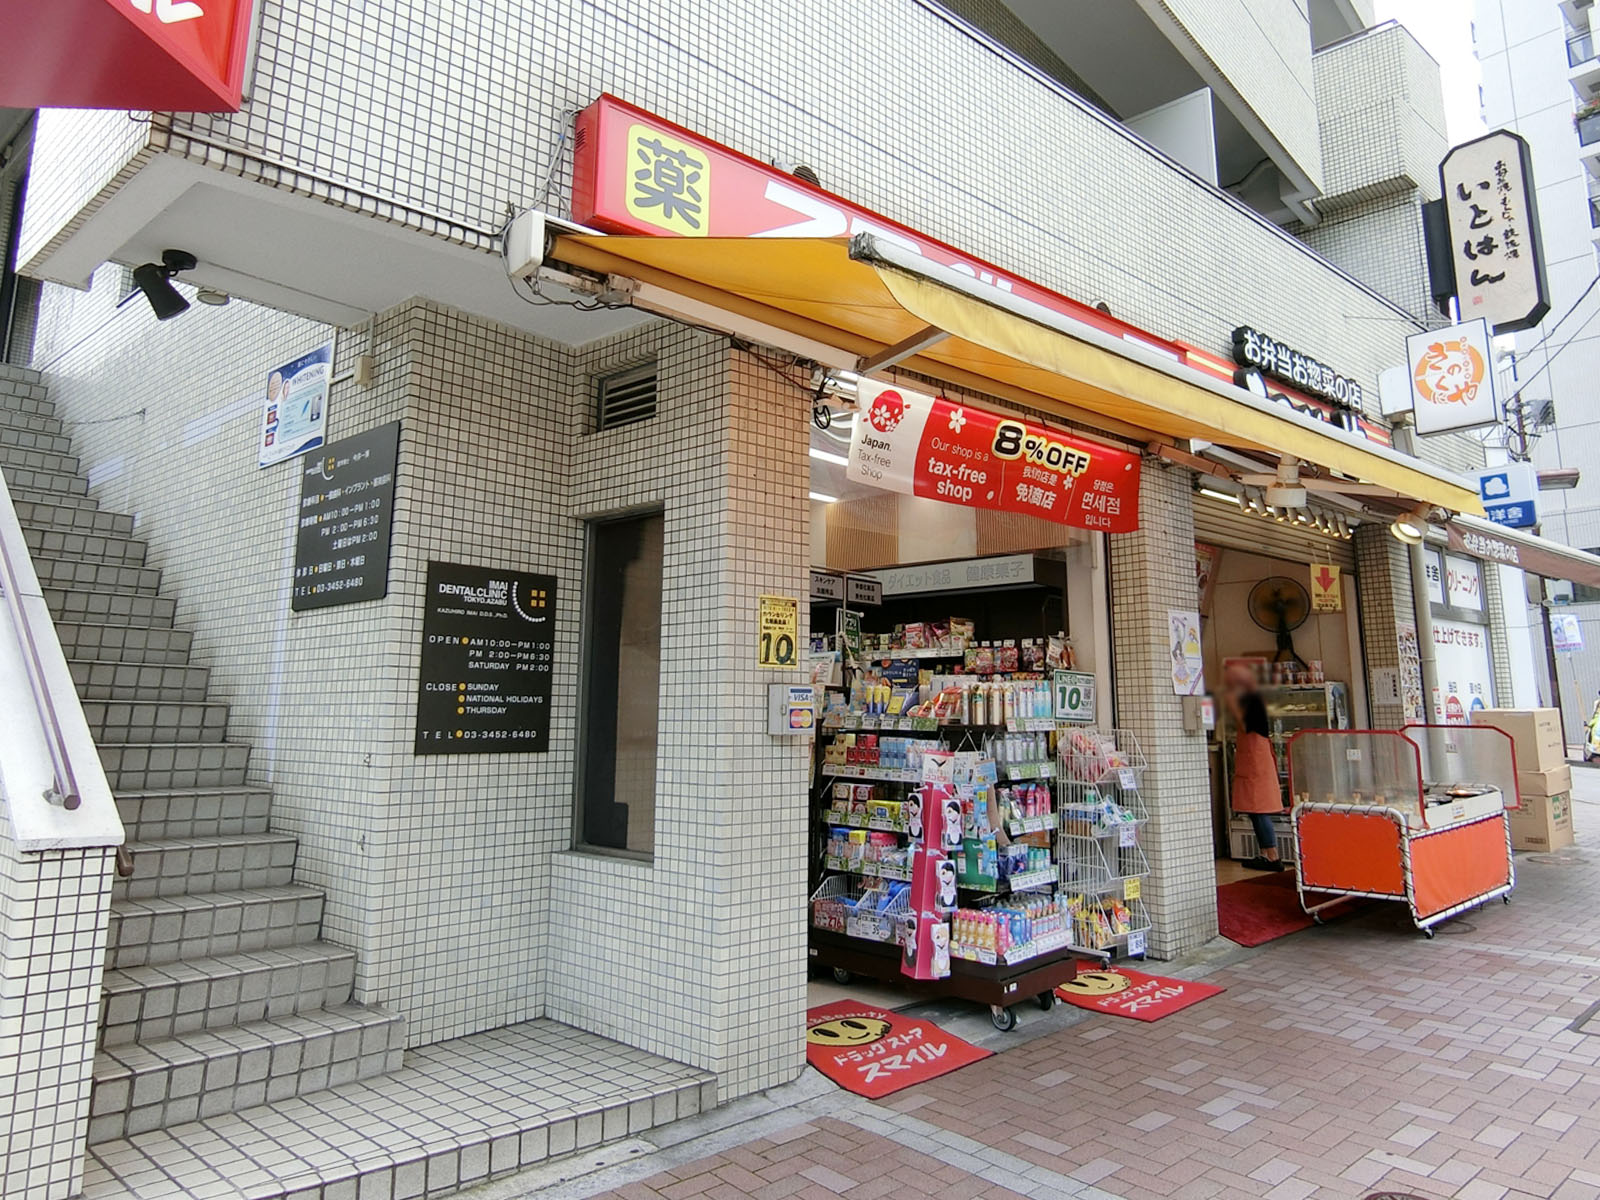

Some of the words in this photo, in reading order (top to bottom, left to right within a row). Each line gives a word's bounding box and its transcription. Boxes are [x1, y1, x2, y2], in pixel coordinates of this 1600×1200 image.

[634, 136, 703, 230] 薬
[1456, 180, 1506, 287] いとはん
[1243, 329, 1362, 413] お弁当お惣菜の店
[861, 434, 892, 452] Japan.
[930, 436, 950, 452] Our
[951, 443, 973, 459] shop
[974, 448, 982, 457] is
[983, 453, 989, 462] a
[858, 449, 891, 468] Tax-free
[860, 464, 883, 480] Shop
[928, 457, 987, 484] tax-free
[936, 479, 973, 502] shop
[1081, 491, 1121, 515] 면세점
[1085, 513, 1112, 528] 입니다
[1487, 505, 1524, 521] 洋舎
[888, 568, 952, 589] ダイエット食品
[966, 560, 1024, 583] 健康菓子
[489, 580, 508, 591] IMAI
[429, 635, 460, 645] OPEN
[762, 631, 794, 665] 10
[469, 650, 483, 658] PM
[468, 661, 510, 671] SATURDAY
[425, 682, 457, 692] CLOSE
[467, 684, 500, 692] SUNDAY
[465, 695, 504, 703] NATIONAL
[506, 696, 543, 704] HOLIDAYS
[793, 692, 809, 702] VISA
[1058, 686, 1081, 710] 10
[466, 706, 507, 715] THURSDAY
[423, 731, 454, 739] TEL
[464, 730, 537, 739] 03-3452-6480
[1120, 985, 1184, 1013] スマイル
[833, 1027, 923, 1067] ドラッグストア
[857, 1042, 948, 1083] スマイル
